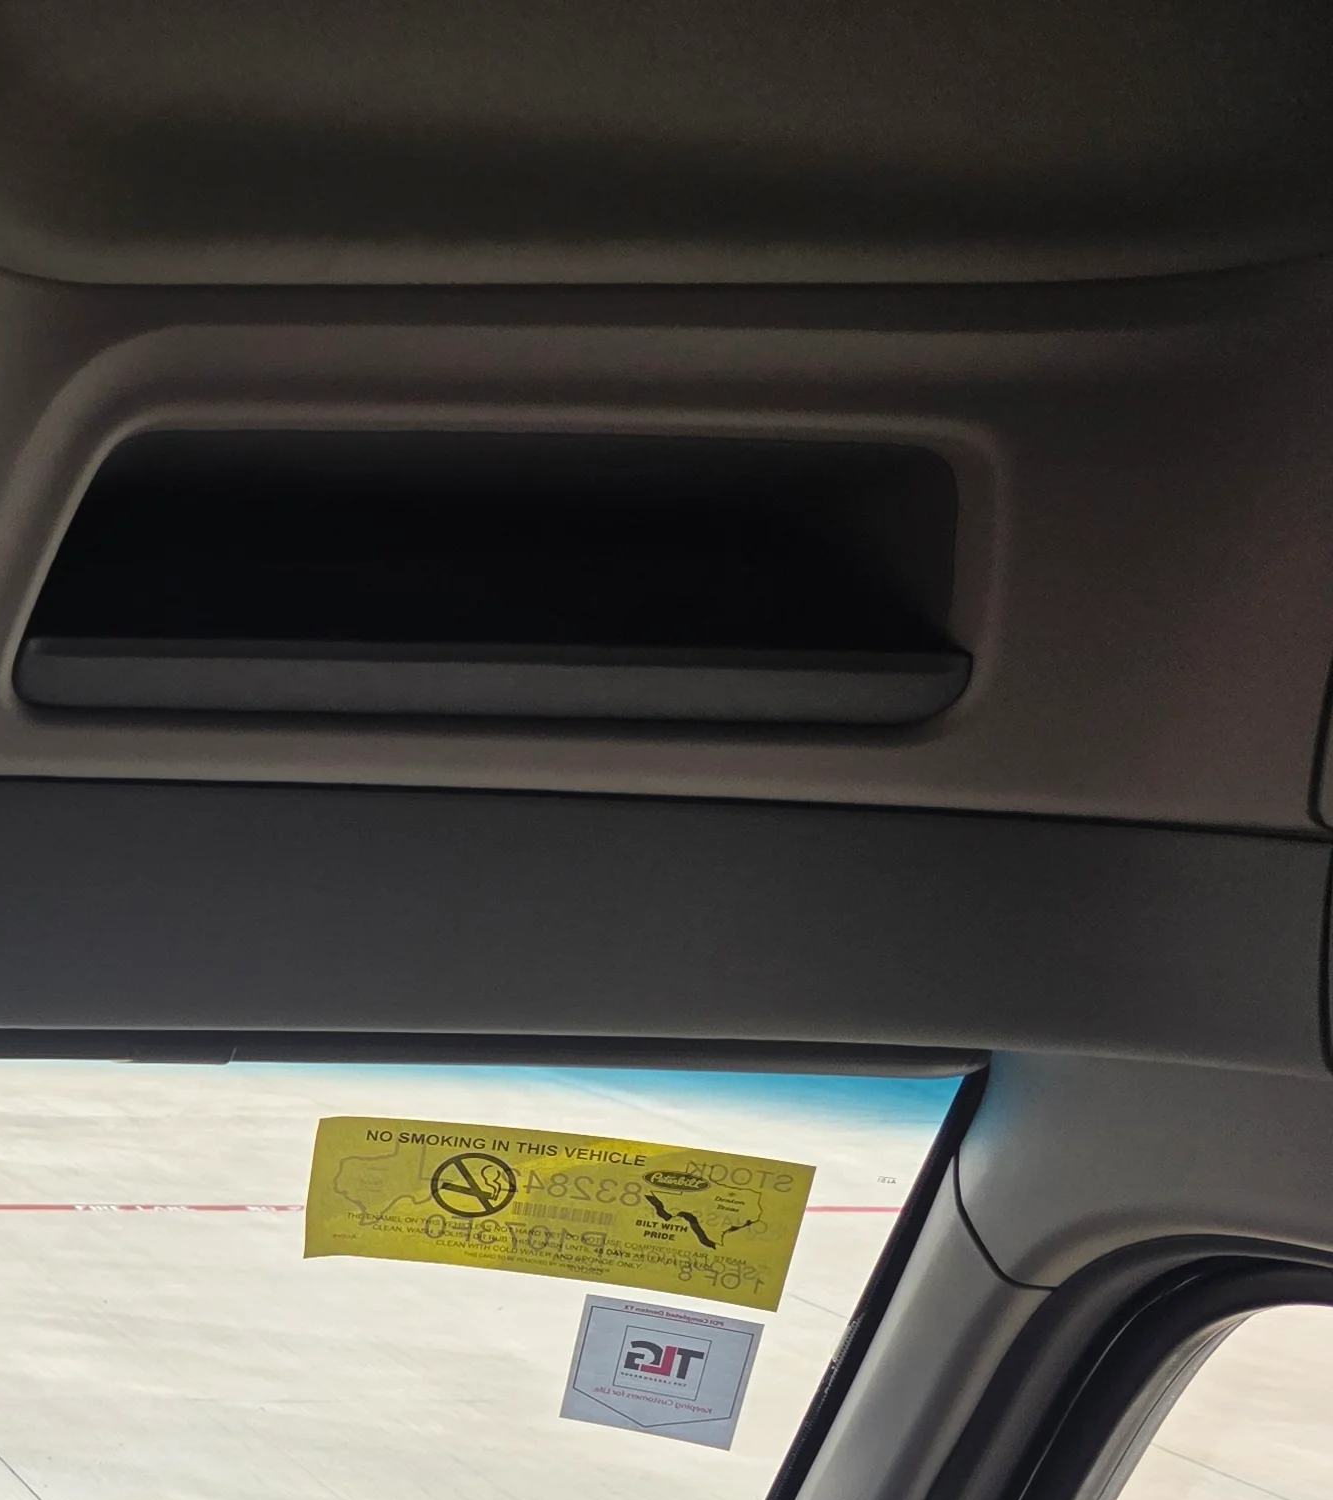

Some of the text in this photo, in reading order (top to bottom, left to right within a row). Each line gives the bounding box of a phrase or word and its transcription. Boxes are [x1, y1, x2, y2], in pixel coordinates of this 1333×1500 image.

[366, 1129, 647, 1167] NO SMOKING IN THIS VEHICLE
[649, 1172, 702, 1191] Peterbilt
[714, 1195, 745, 1206] Denton
[717, 1205, 739, 1213] Texas
[635, 1219, 688, 1234] BILT WITH
[566, 1233, 579, 1241] DO
[643, 1230, 675, 1241] PRIDE
[436, 1239, 465, 1248] CLEAN
[468, 1242, 490, 1250] WITH
[493, 1244, 518, 1253] COLD
[520, 1247, 551, 1257] WATER
[606, 1249, 630, 1258] DAYS
